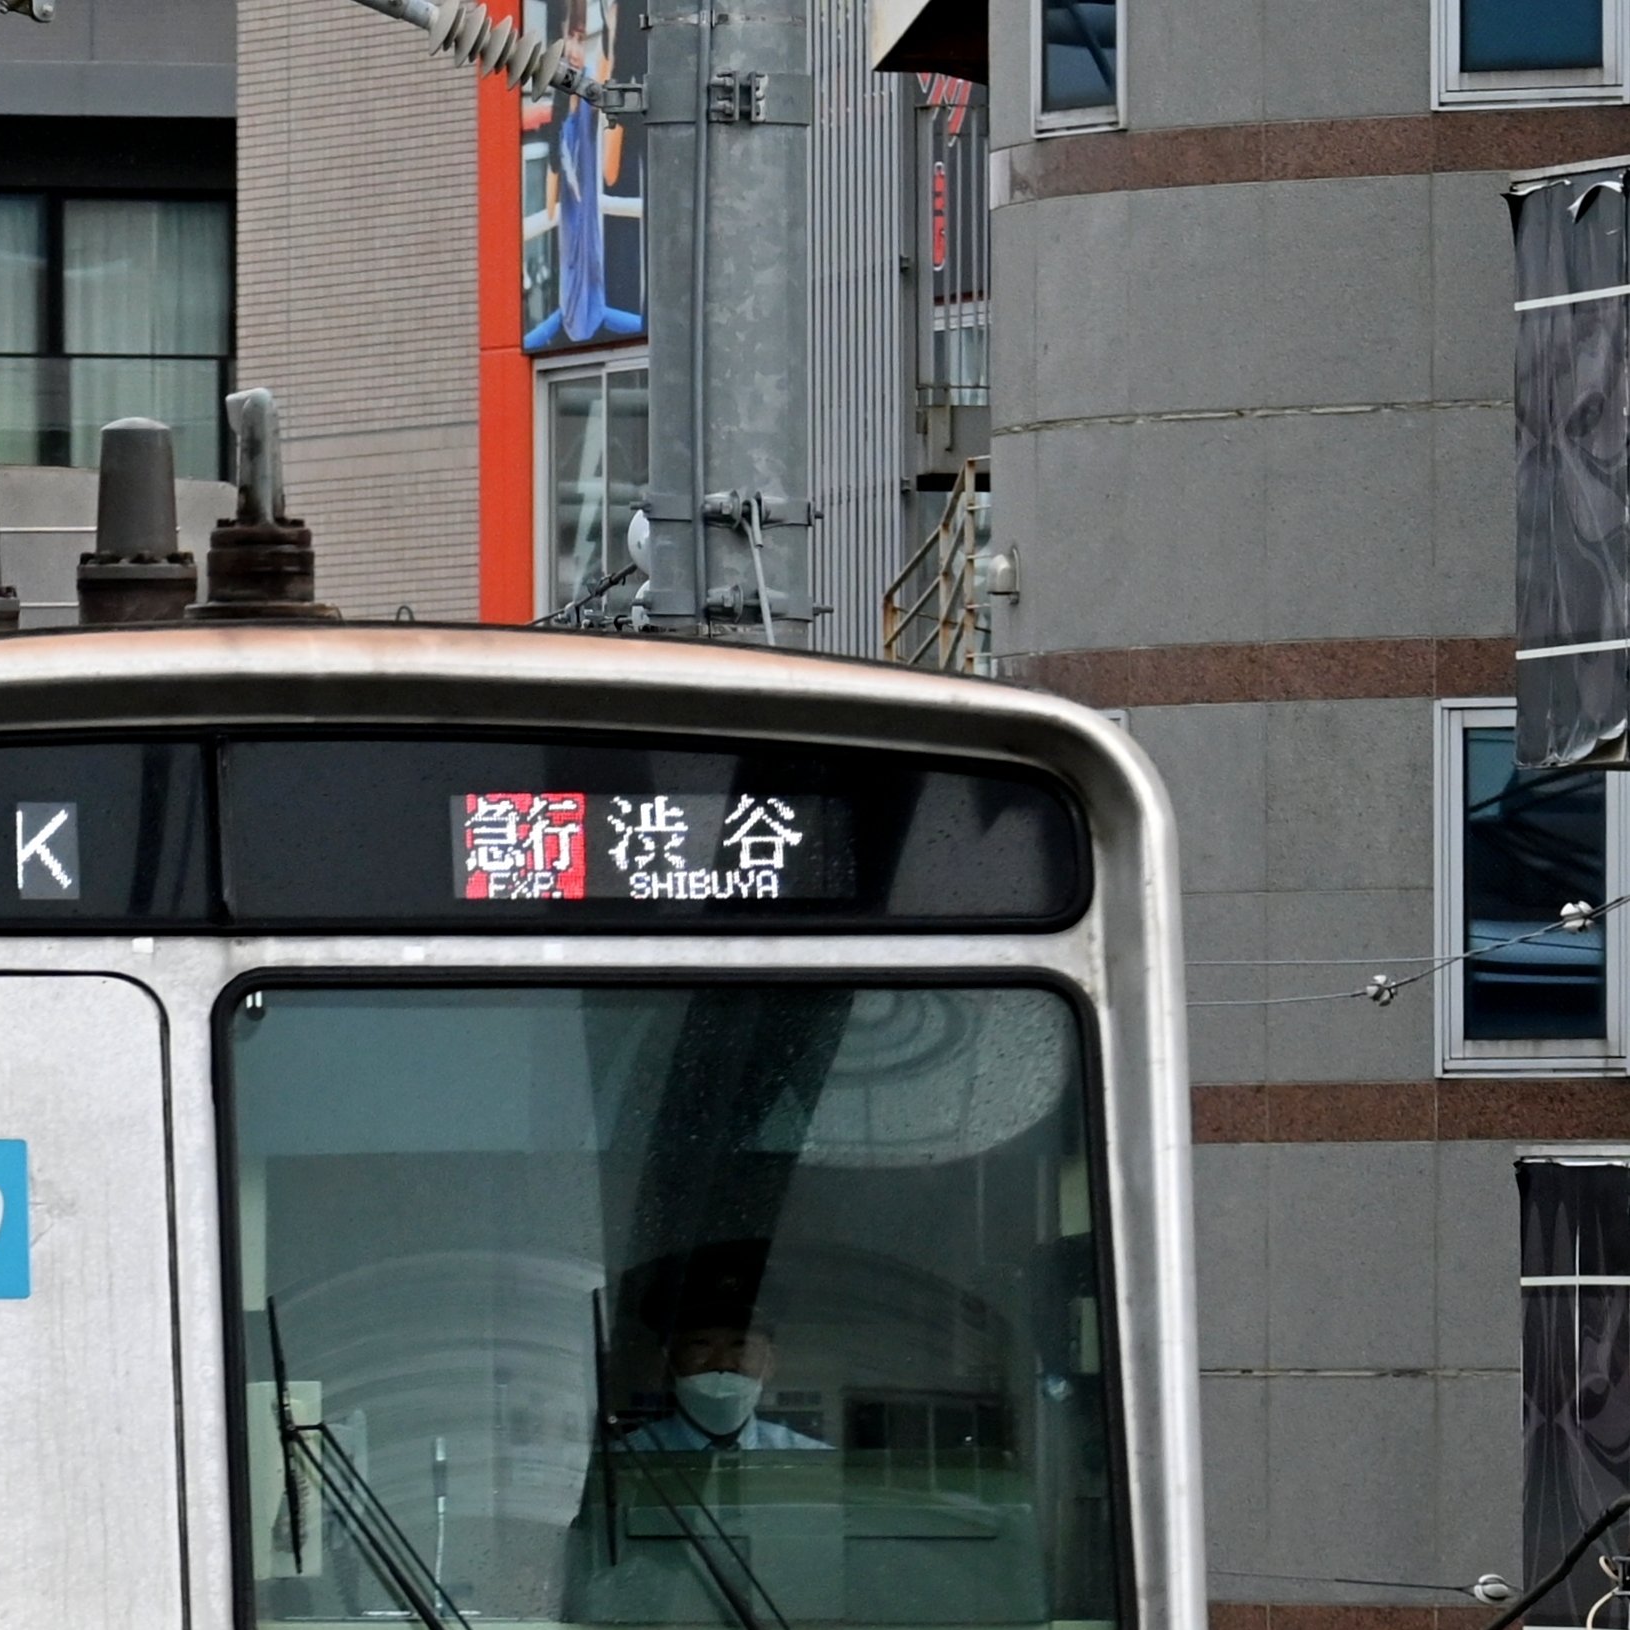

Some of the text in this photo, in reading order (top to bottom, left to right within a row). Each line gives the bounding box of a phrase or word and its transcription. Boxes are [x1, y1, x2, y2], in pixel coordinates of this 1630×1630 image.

[465, 794, 803, 871] 急行 渋谷
[629, 868, 779, 900] SHIBUYA
